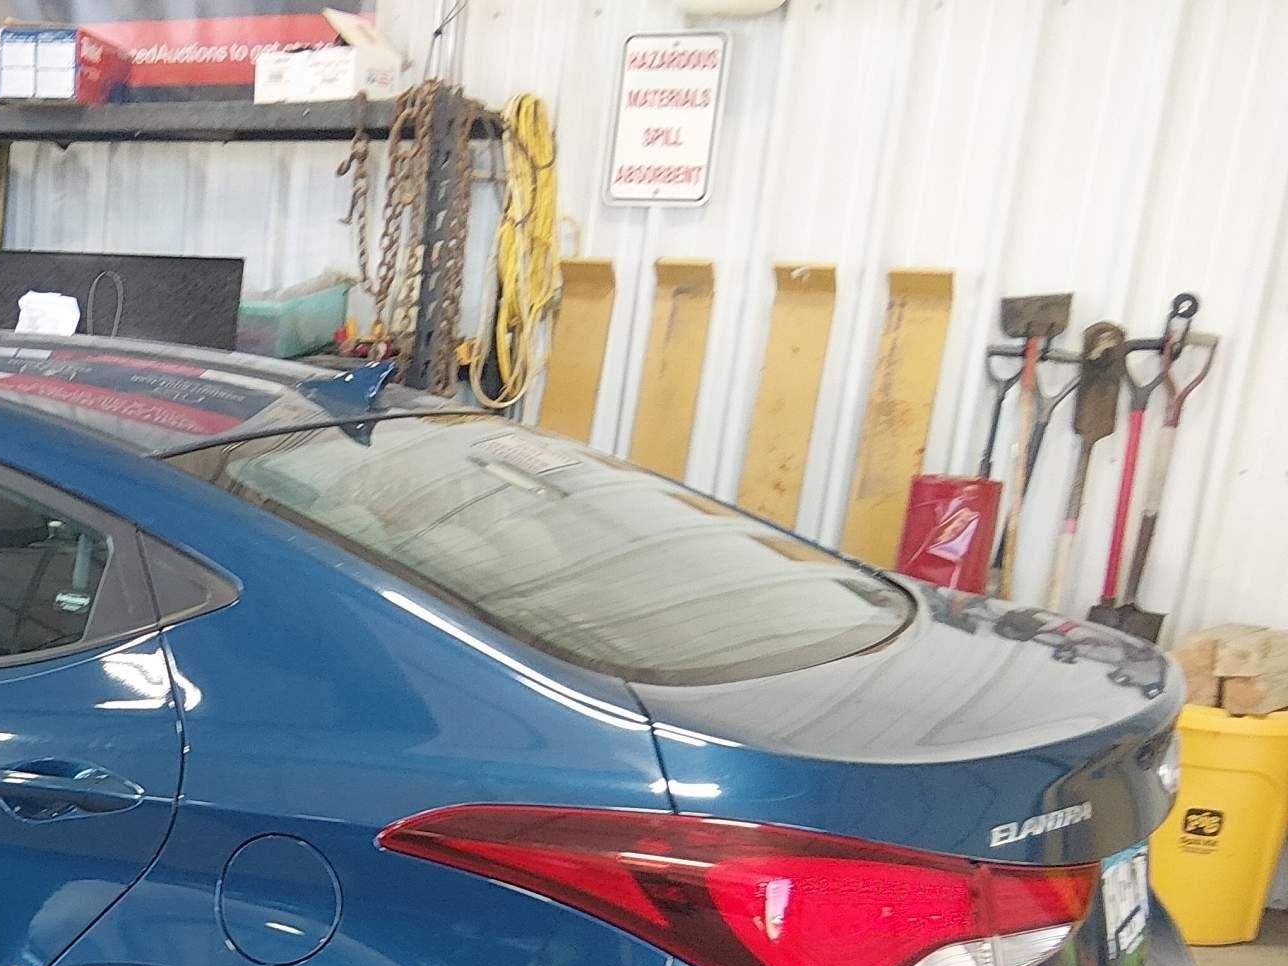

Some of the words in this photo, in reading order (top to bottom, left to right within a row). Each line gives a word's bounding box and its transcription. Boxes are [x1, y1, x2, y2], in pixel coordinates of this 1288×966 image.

[229, 42, 249, 62] to
[627, 49, 719, 71] HAZARDOUS
[626, 87, 712, 109] MATERIALS
[643, 127, 682, 146] SPILL
[615, 165, 704, 185] ABSORBENT
[989, 801, 1093, 848] ELANTRA
